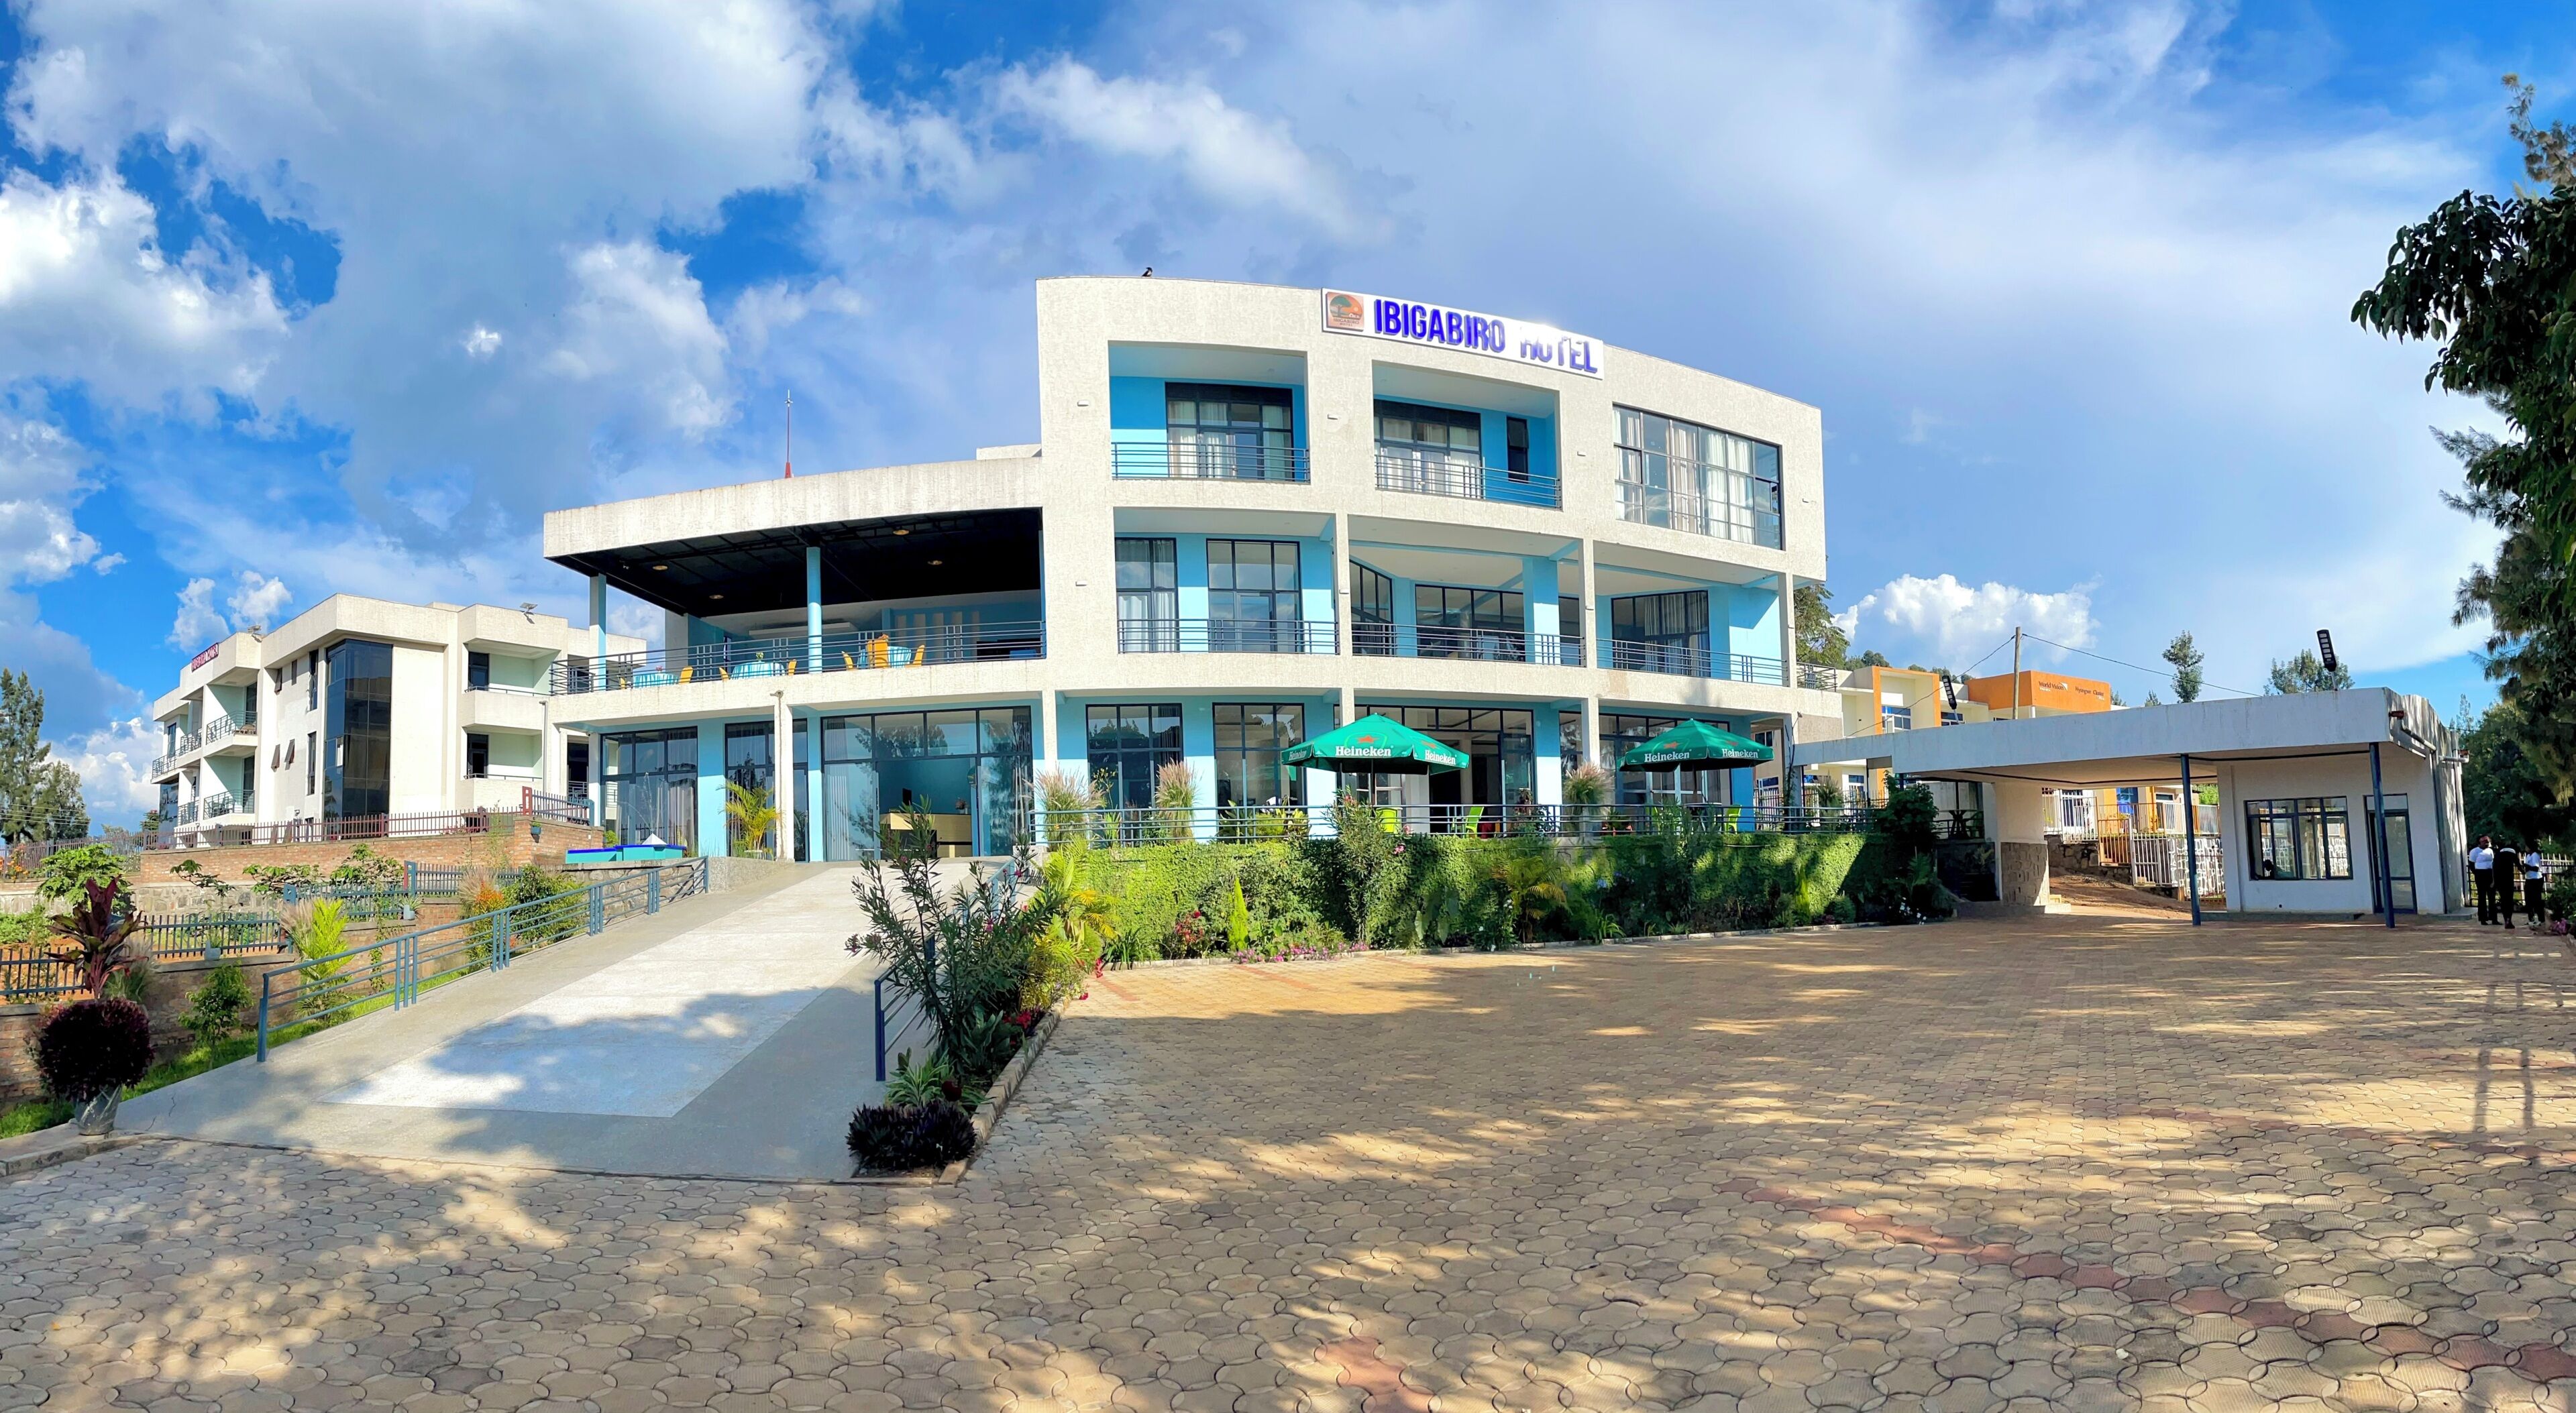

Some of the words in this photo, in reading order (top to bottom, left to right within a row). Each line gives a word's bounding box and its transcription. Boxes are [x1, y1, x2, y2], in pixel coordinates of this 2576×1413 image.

[1374, 298, 1505, 353] IBIGABIRO
[2051, 683, 2064, 691] Vision
[1288, 749, 1307, 761] Heineken
[1336, 746, 1391, 756] Heineken
[1644, 751, 1690, 762] Heineken
[1721, 748, 1758, 758] Heineken
[1425, 749, 1456, 765] Heineken
